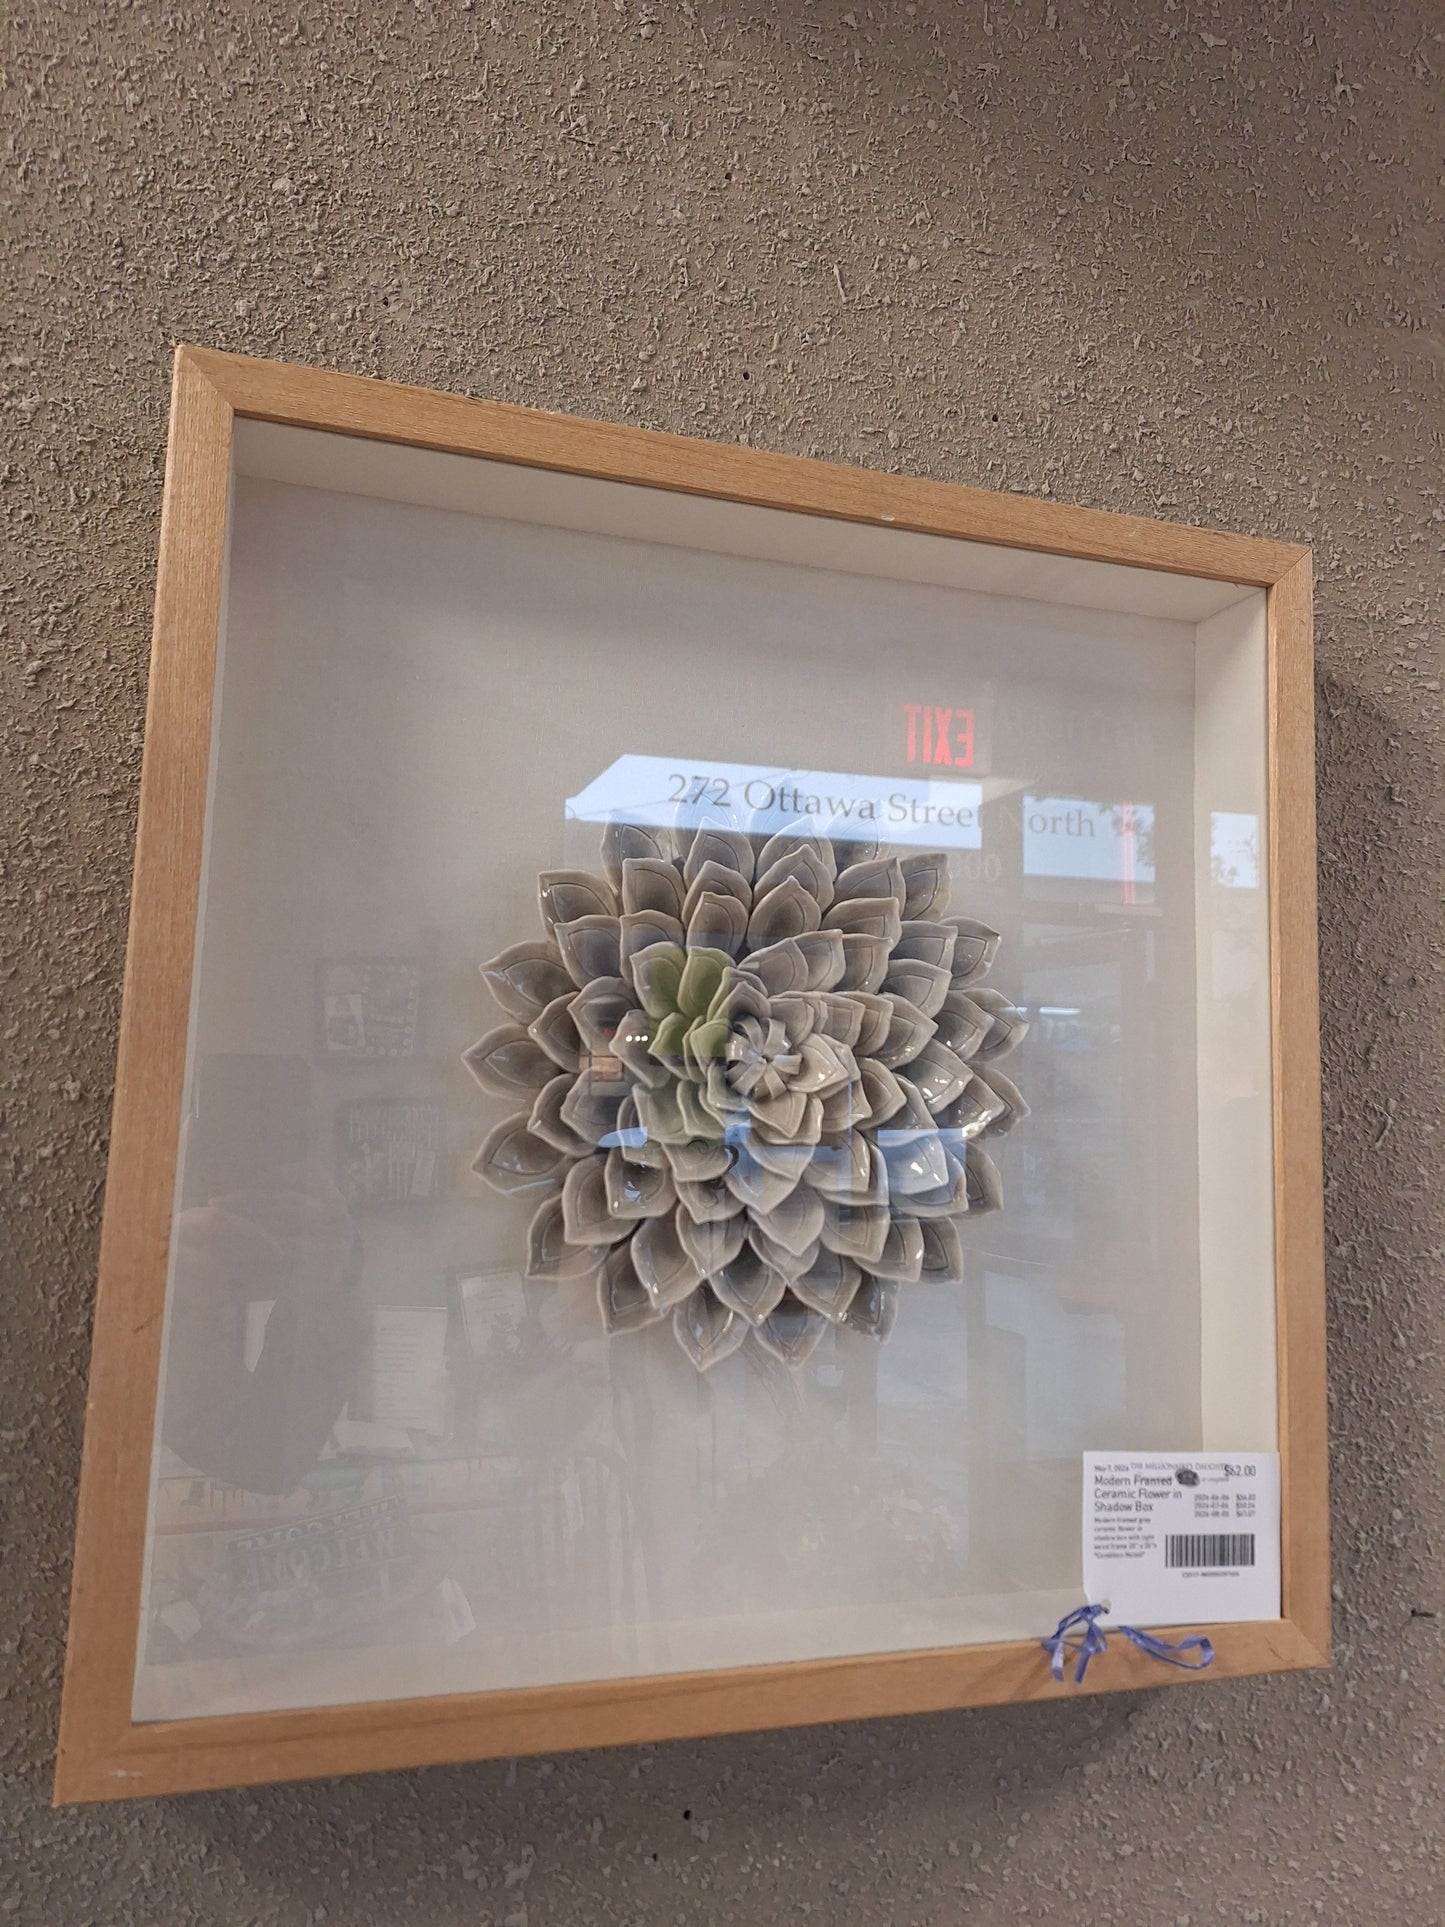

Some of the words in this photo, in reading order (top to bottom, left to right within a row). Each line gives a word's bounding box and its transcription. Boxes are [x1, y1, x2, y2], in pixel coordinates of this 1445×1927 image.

[667, 773, 732, 807] 272
[743, 779, 876, 820] Ottawa
[1094, 1474, 1131, 1486] Modern
[1134, 1474, 1172, 1486] Framed
[1094, 1488, 1136, 1499] Ceramic
[1139, 1488, 1170, 1499] Flower
[1173, 1488, 1182, 1499] in
[1094, 1501, 1133, 1512] Shadow
[1135, 1501, 1153, 1512] Box
